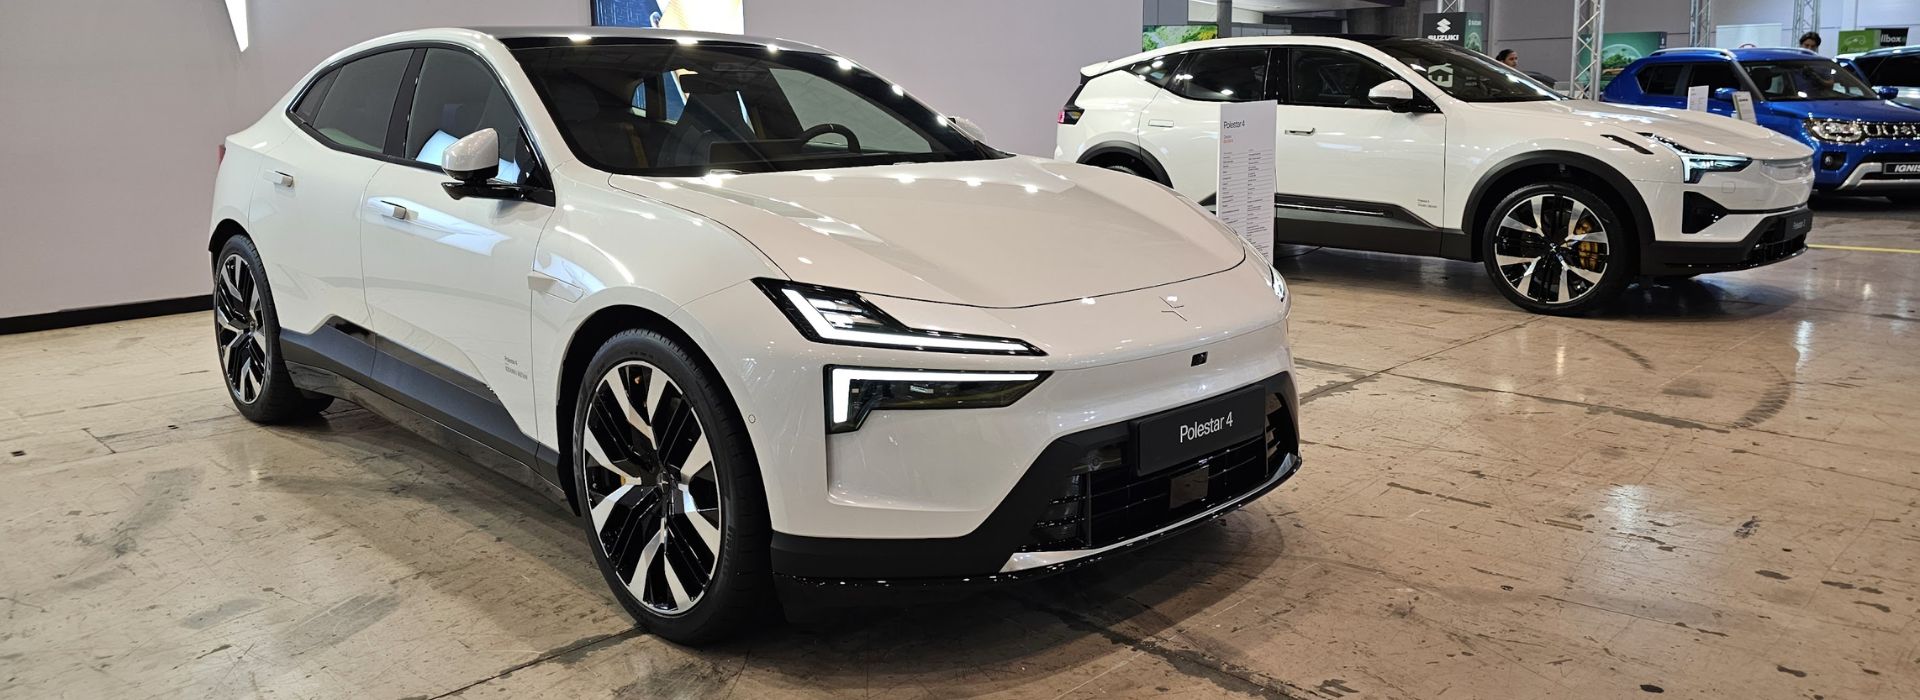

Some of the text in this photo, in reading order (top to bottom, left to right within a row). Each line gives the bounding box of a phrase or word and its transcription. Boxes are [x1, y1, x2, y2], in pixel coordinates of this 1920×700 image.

[1223, 120, 1241, 129] Polestar
[1180, 411, 1234, 443] Polestar 4
